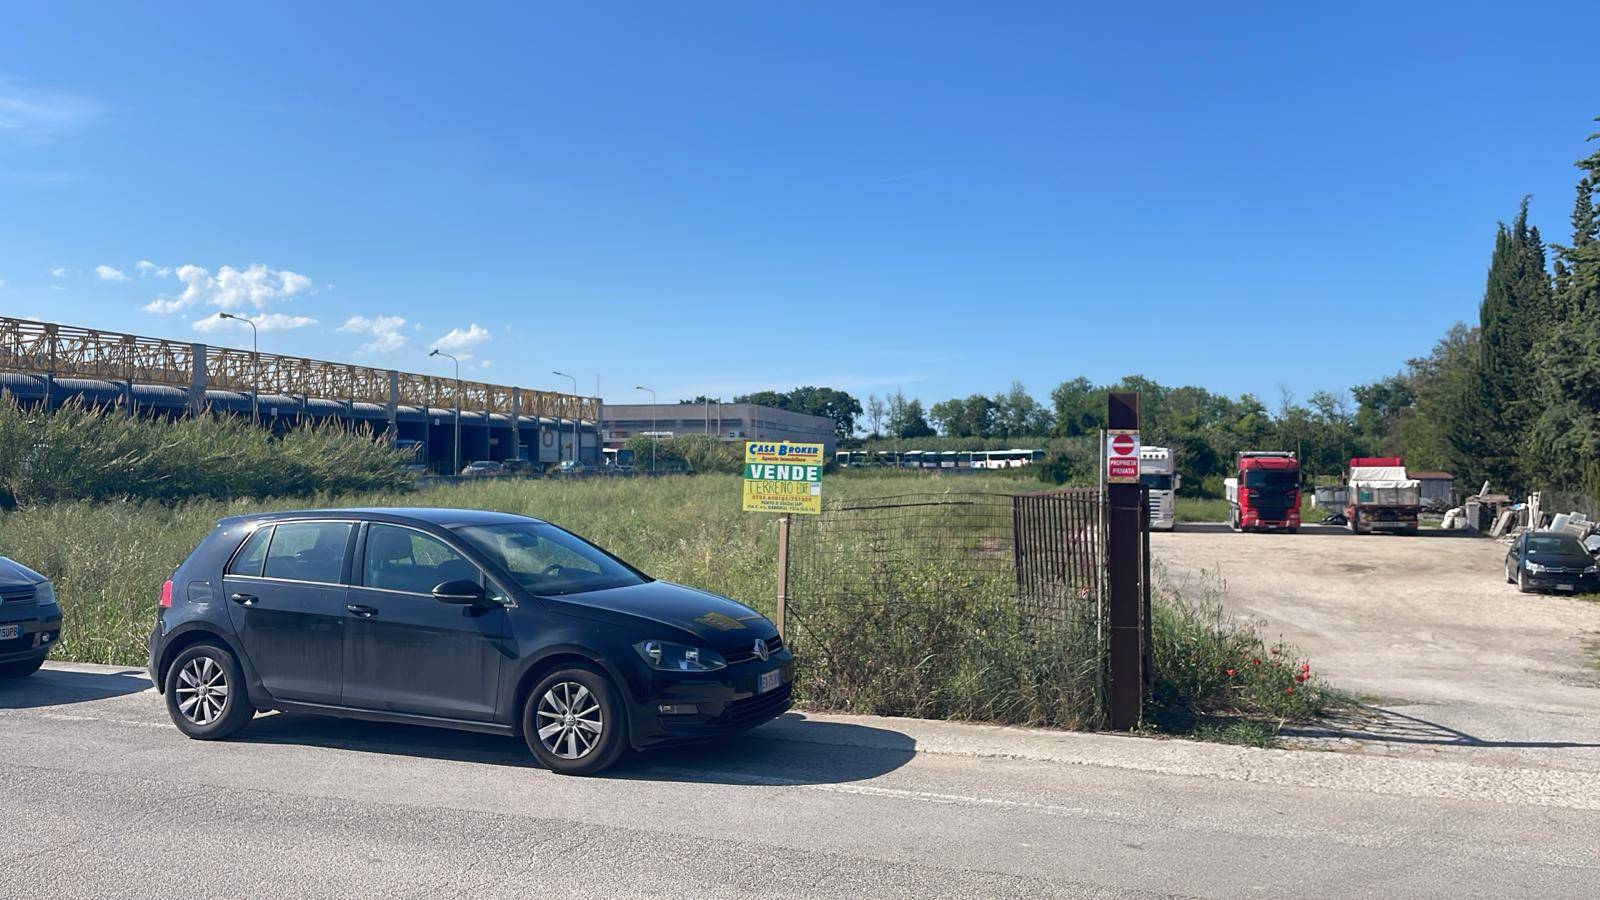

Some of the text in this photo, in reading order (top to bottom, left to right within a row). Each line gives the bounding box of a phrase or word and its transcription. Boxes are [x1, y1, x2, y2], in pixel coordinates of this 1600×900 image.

[749, 444, 819, 456] CASA BROKER
[750, 464, 818, 481] VENDE
[746, 481, 793, 495] TERRENO
